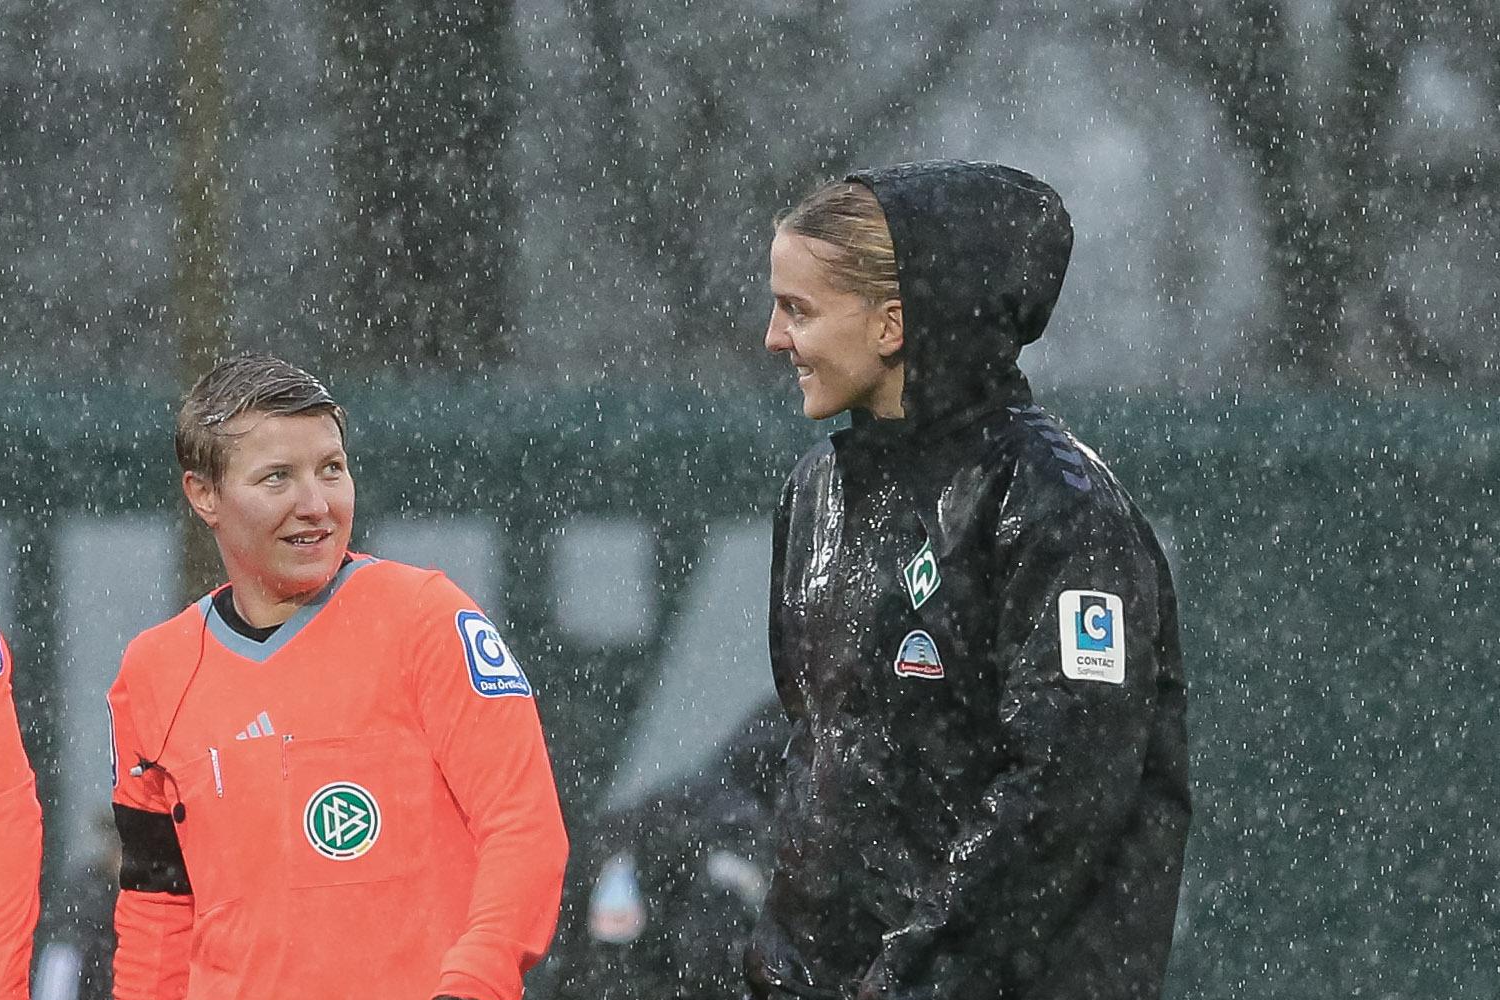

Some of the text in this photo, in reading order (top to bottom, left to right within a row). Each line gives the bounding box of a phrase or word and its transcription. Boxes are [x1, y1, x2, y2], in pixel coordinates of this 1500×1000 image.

[1084, 605, 1107, 640] C
[1077, 656, 1114, 668] CONTACT
[480, 680, 497, 691] Das
